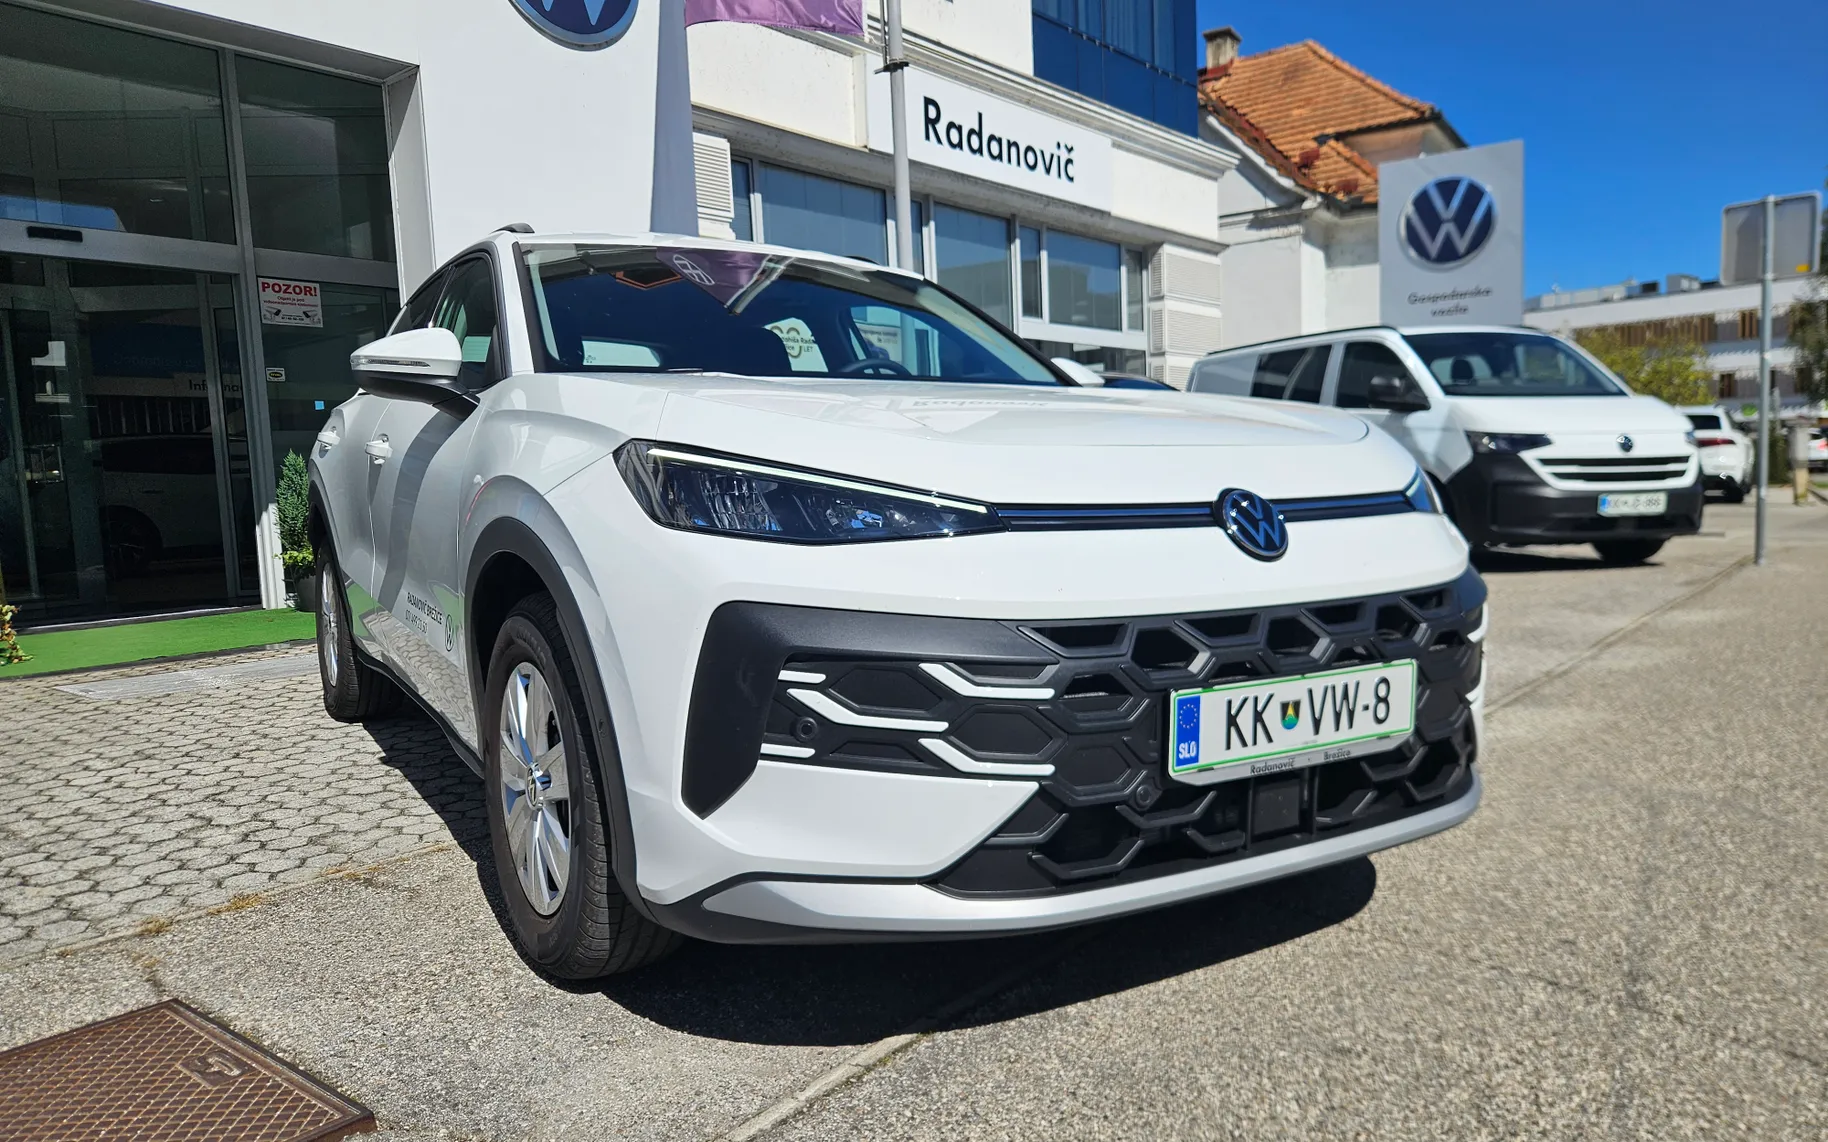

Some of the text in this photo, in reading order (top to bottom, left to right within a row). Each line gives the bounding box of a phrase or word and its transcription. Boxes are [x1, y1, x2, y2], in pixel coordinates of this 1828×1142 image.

[923, 95, 1075, 183] Radanovič
[261, 282, 318, 296] POZOR!
[1225, 676, 1391, 750] KK VW-8
[1179, 741, 1197, 760] SLO
[1250, 757, 1296, 774] Radanovič
